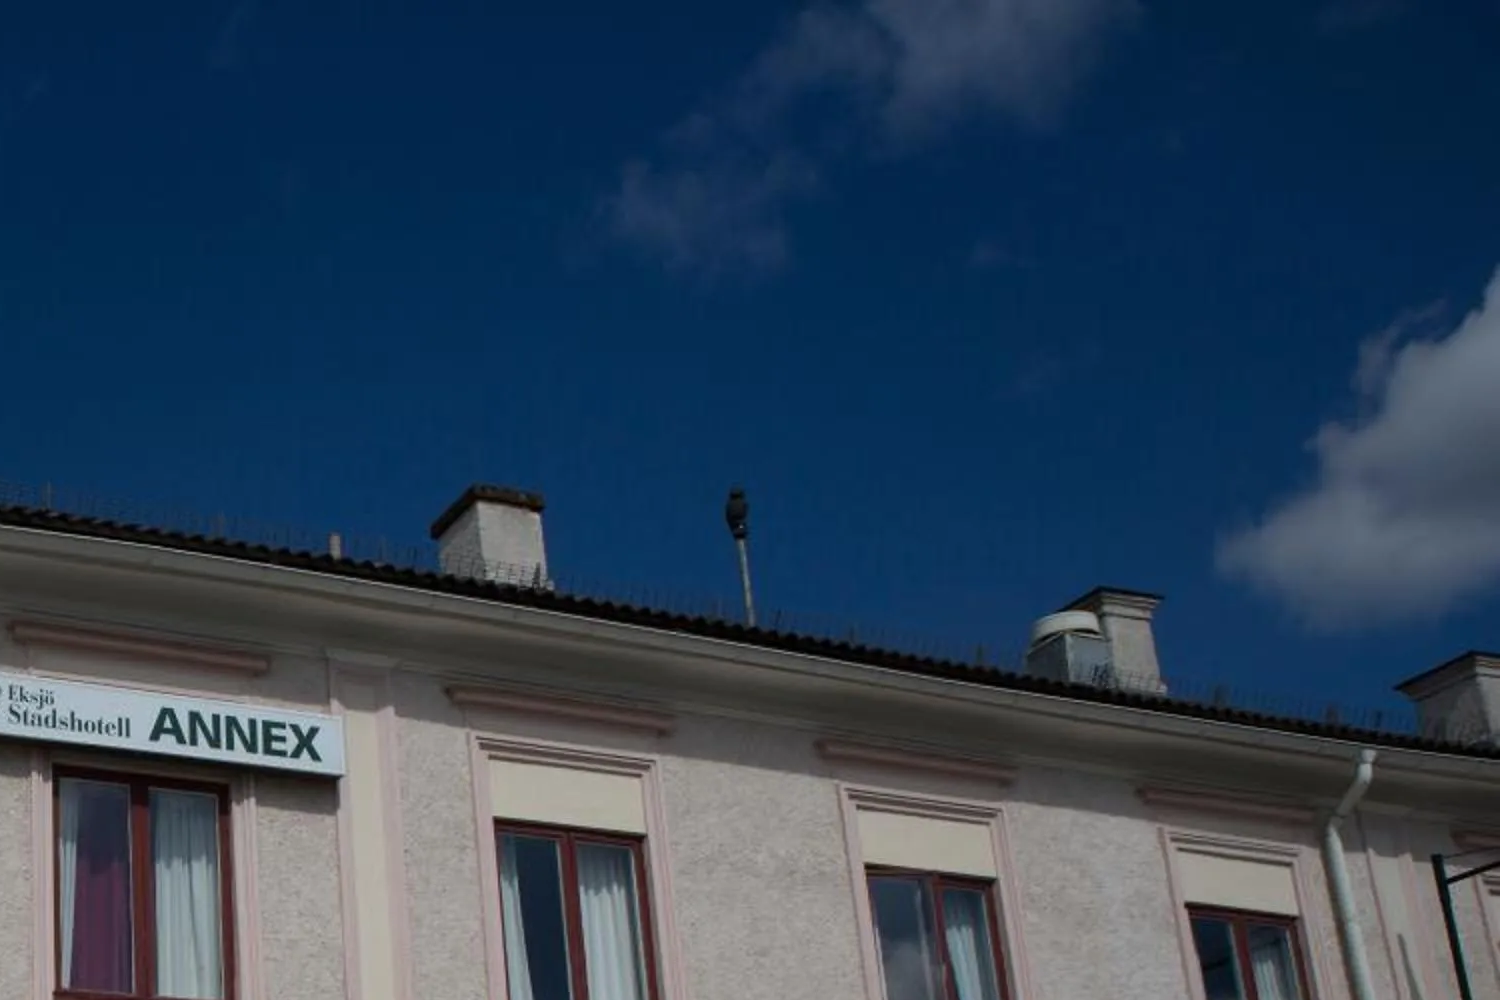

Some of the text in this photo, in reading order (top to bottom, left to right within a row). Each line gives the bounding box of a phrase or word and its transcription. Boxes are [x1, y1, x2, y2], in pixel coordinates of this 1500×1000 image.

[8, 685, 55, 709] Eksjö
[8, 704, 131, 739] Stadshotell
[149, 707, 323, 762] ANNEX
